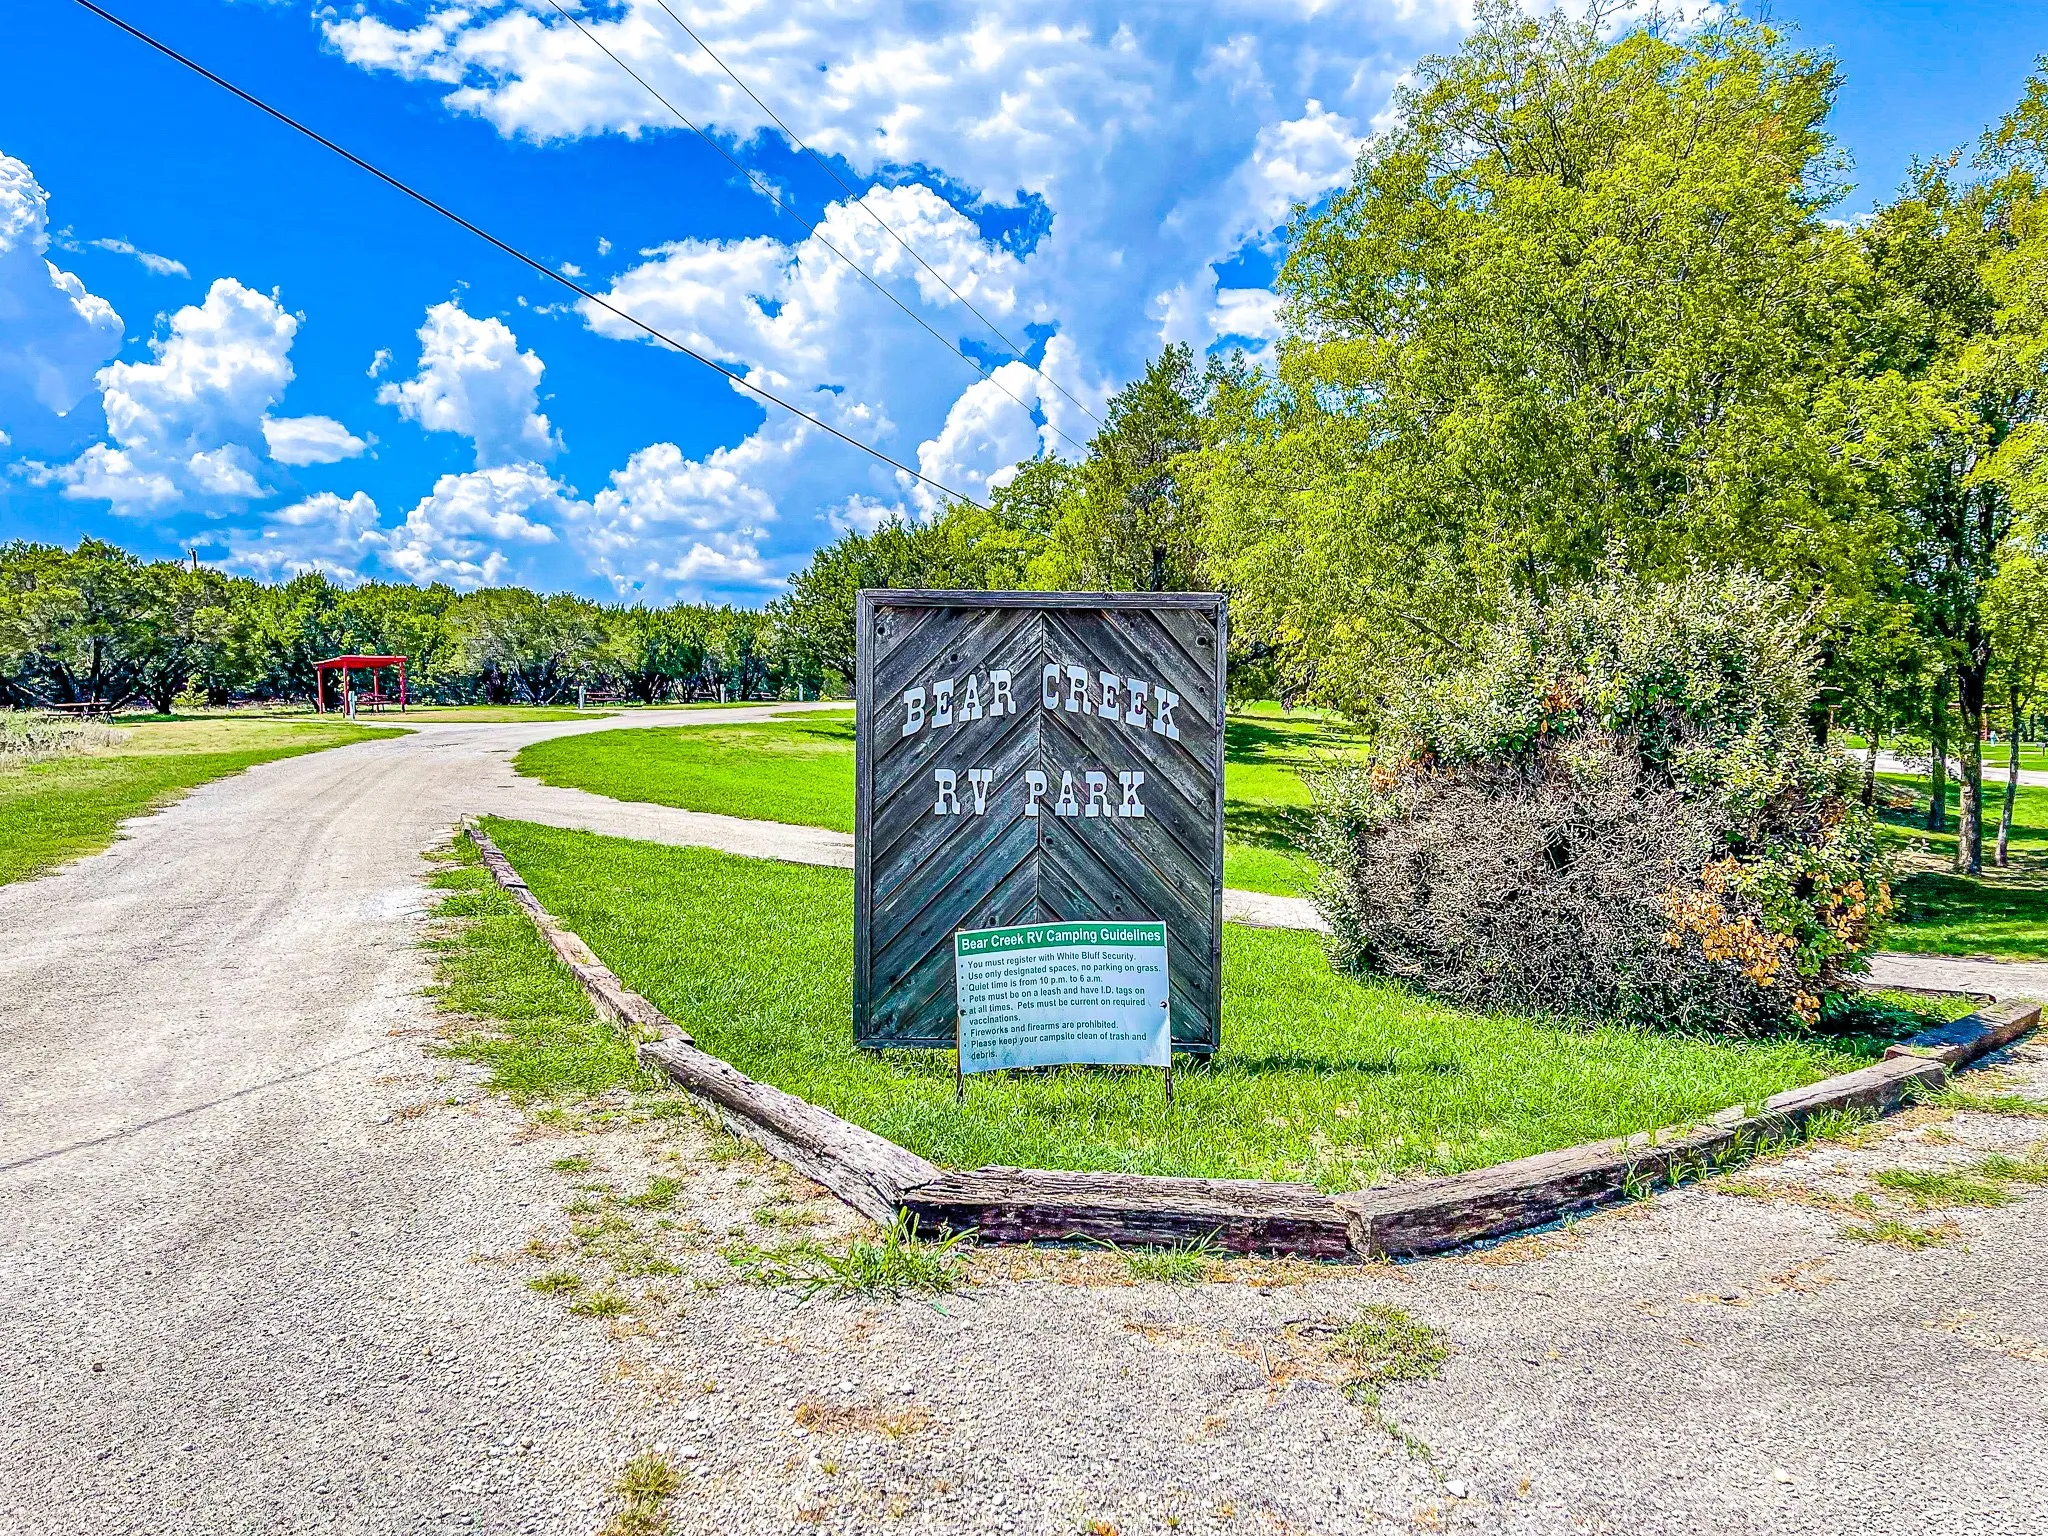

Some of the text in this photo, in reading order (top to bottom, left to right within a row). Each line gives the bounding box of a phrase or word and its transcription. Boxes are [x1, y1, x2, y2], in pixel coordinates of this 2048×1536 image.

[902, 663, 1181, 741] BEAR CREEK
[934, 768, 1145, 818] RV PARK
[962, 928, 1161, 950] Bear Creek RV Camping Guidelines
[968, 951, 1136, 969] You must register with White Bluff Security.
[968, 972, 983, 980] Use
[985, 970, 1002, 979] only
[1003, 965, 1047, 977] designated
[1049, 963, 1079, 974] spaces,
[1093, 963, 1123, 973] parking
[1136, 964, 1161, 973] grass.
[968, 982, 990, 992] Quiet
[991, 980, 1008, 989] time
[1010, 979, 1017, 987] is
[1019, 978, 1038, 987] from
[1040, 976, 1049, 985] 10
[1050, 977, 1068, 985] p.m.
[1069, 975, 1078, 983] to
[1079, 974, 1085, 983] 6
[969, 995, 986, 1003] Pets
[988, 992, 1008, 1001] must
[1009, 991, 1020, 999] be
[1040, 987, 1061, 996] leash
[1063, 986, 1078, 995] and
[1080, 986, 1099, 994] have
[1101, 986, 1114, 994] I.D.
[1115, 986, 1133, 996] tags
[969, 998, 1146, 1015] at all times. Pets must be current on required
[969, 1013, 1021, 1026] vaccinations.
[970, 1020, 1119, 1037] Fireworks and firearms are prohibited.
[971, 1031, 1147, 1049] Please keep your campsite clean of trash and
[971, 1050, 998, 1060] debris.
